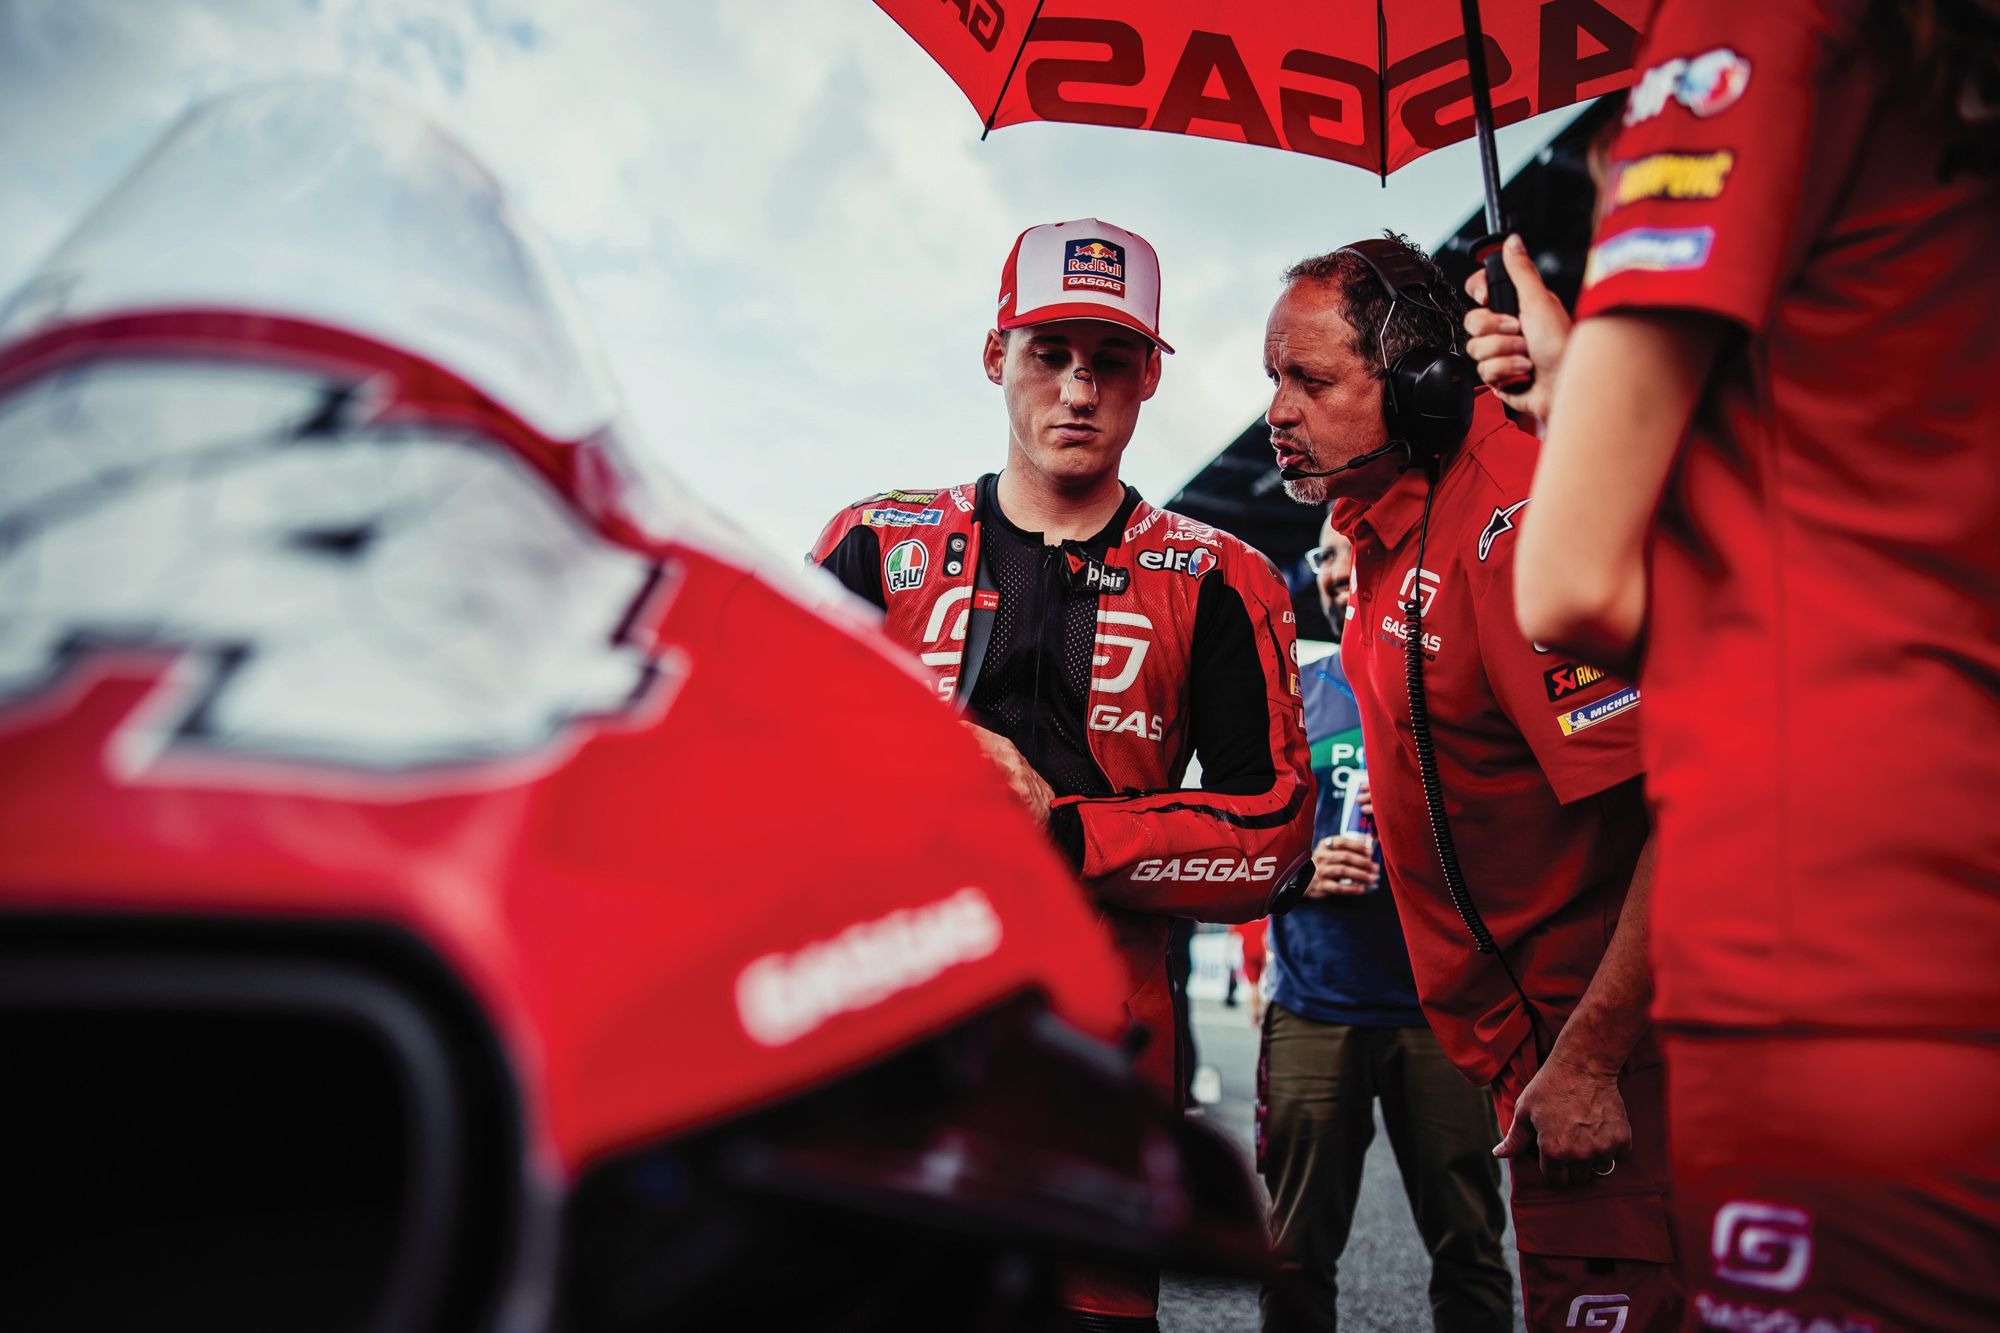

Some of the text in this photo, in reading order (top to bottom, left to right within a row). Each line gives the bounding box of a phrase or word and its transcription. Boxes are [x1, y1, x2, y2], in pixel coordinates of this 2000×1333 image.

[1068, 258, 1122, 278] Red Bull
[1068, 277, 1121, 291] GASGAS
[1381, 615, 1442, 652] GASAS
[1590, 690, 1641, 719] MICHELI
[1130, 857, 1277, 882] GASGAS
